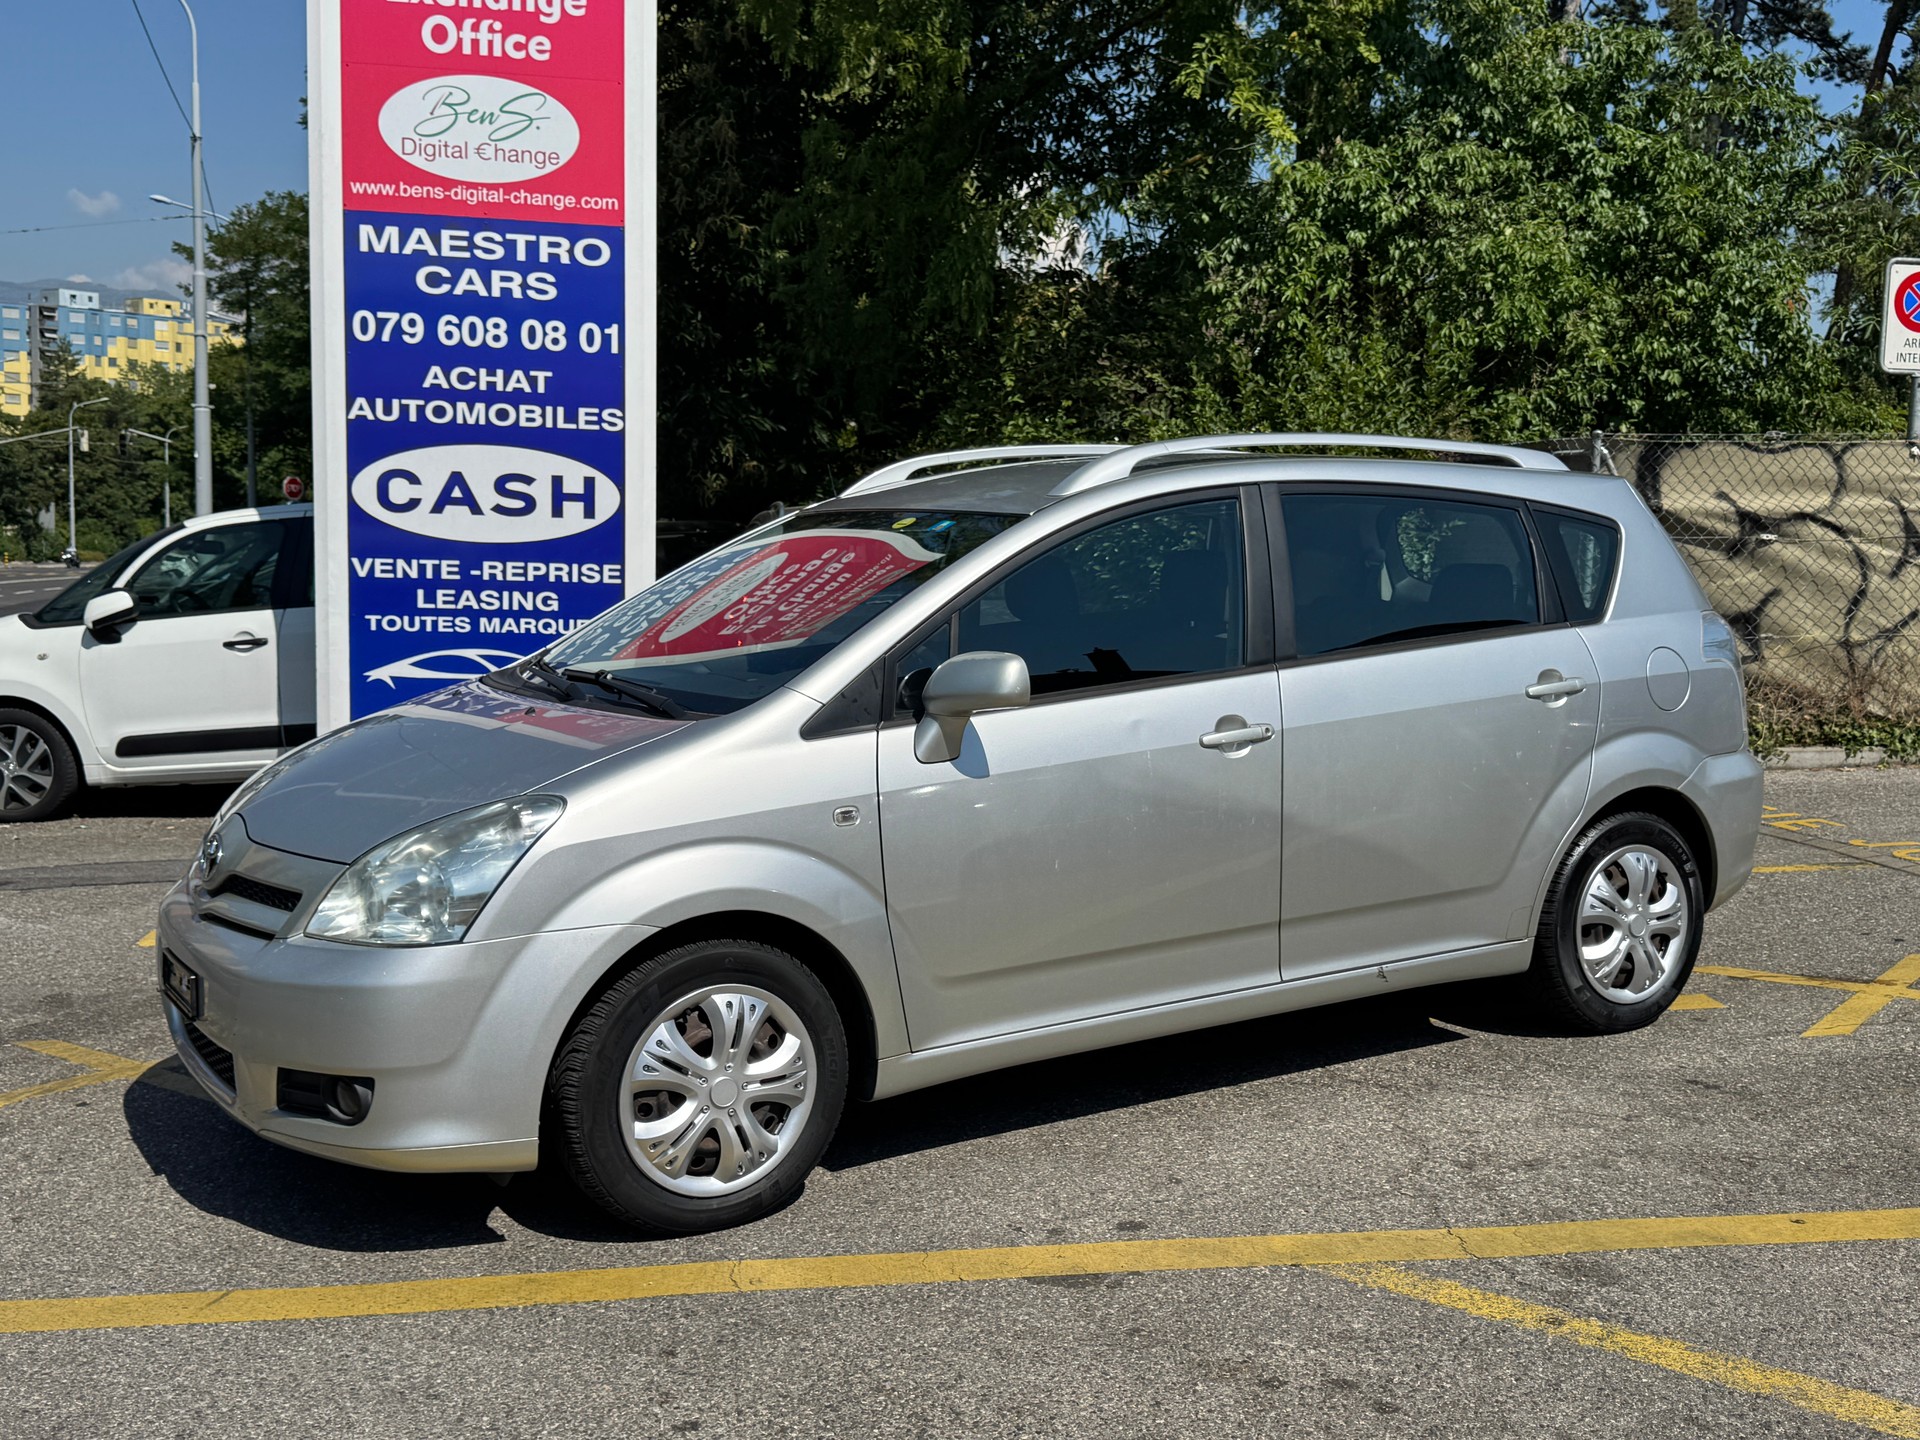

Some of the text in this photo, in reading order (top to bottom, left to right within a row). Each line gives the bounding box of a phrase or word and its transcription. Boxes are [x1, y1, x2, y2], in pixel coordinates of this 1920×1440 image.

[421, 14, 552, 62] Office
[401, 136, 468, 162] Digital
[350, 180, 619, 210] www.bens-digital-change.com
[358, 224, 611, 267] MAESTRO
[415, 265, 558, 301] CARS
[352, 310, 619, 354] 079 608 08 01
[1903, 337, 1920, 348] AR
[1896, 352, 1920, 363] INTE
[422, 365, 553, 394] ACHAT
[347, 397, 624, 432] AUTOMOBILES
[376, 468, 596, 519] CASH
[350, 557, 460, 579] VENTE
[417, 589, 559, 611] LEASING
[364, 615, 471, 633] TOUTES
